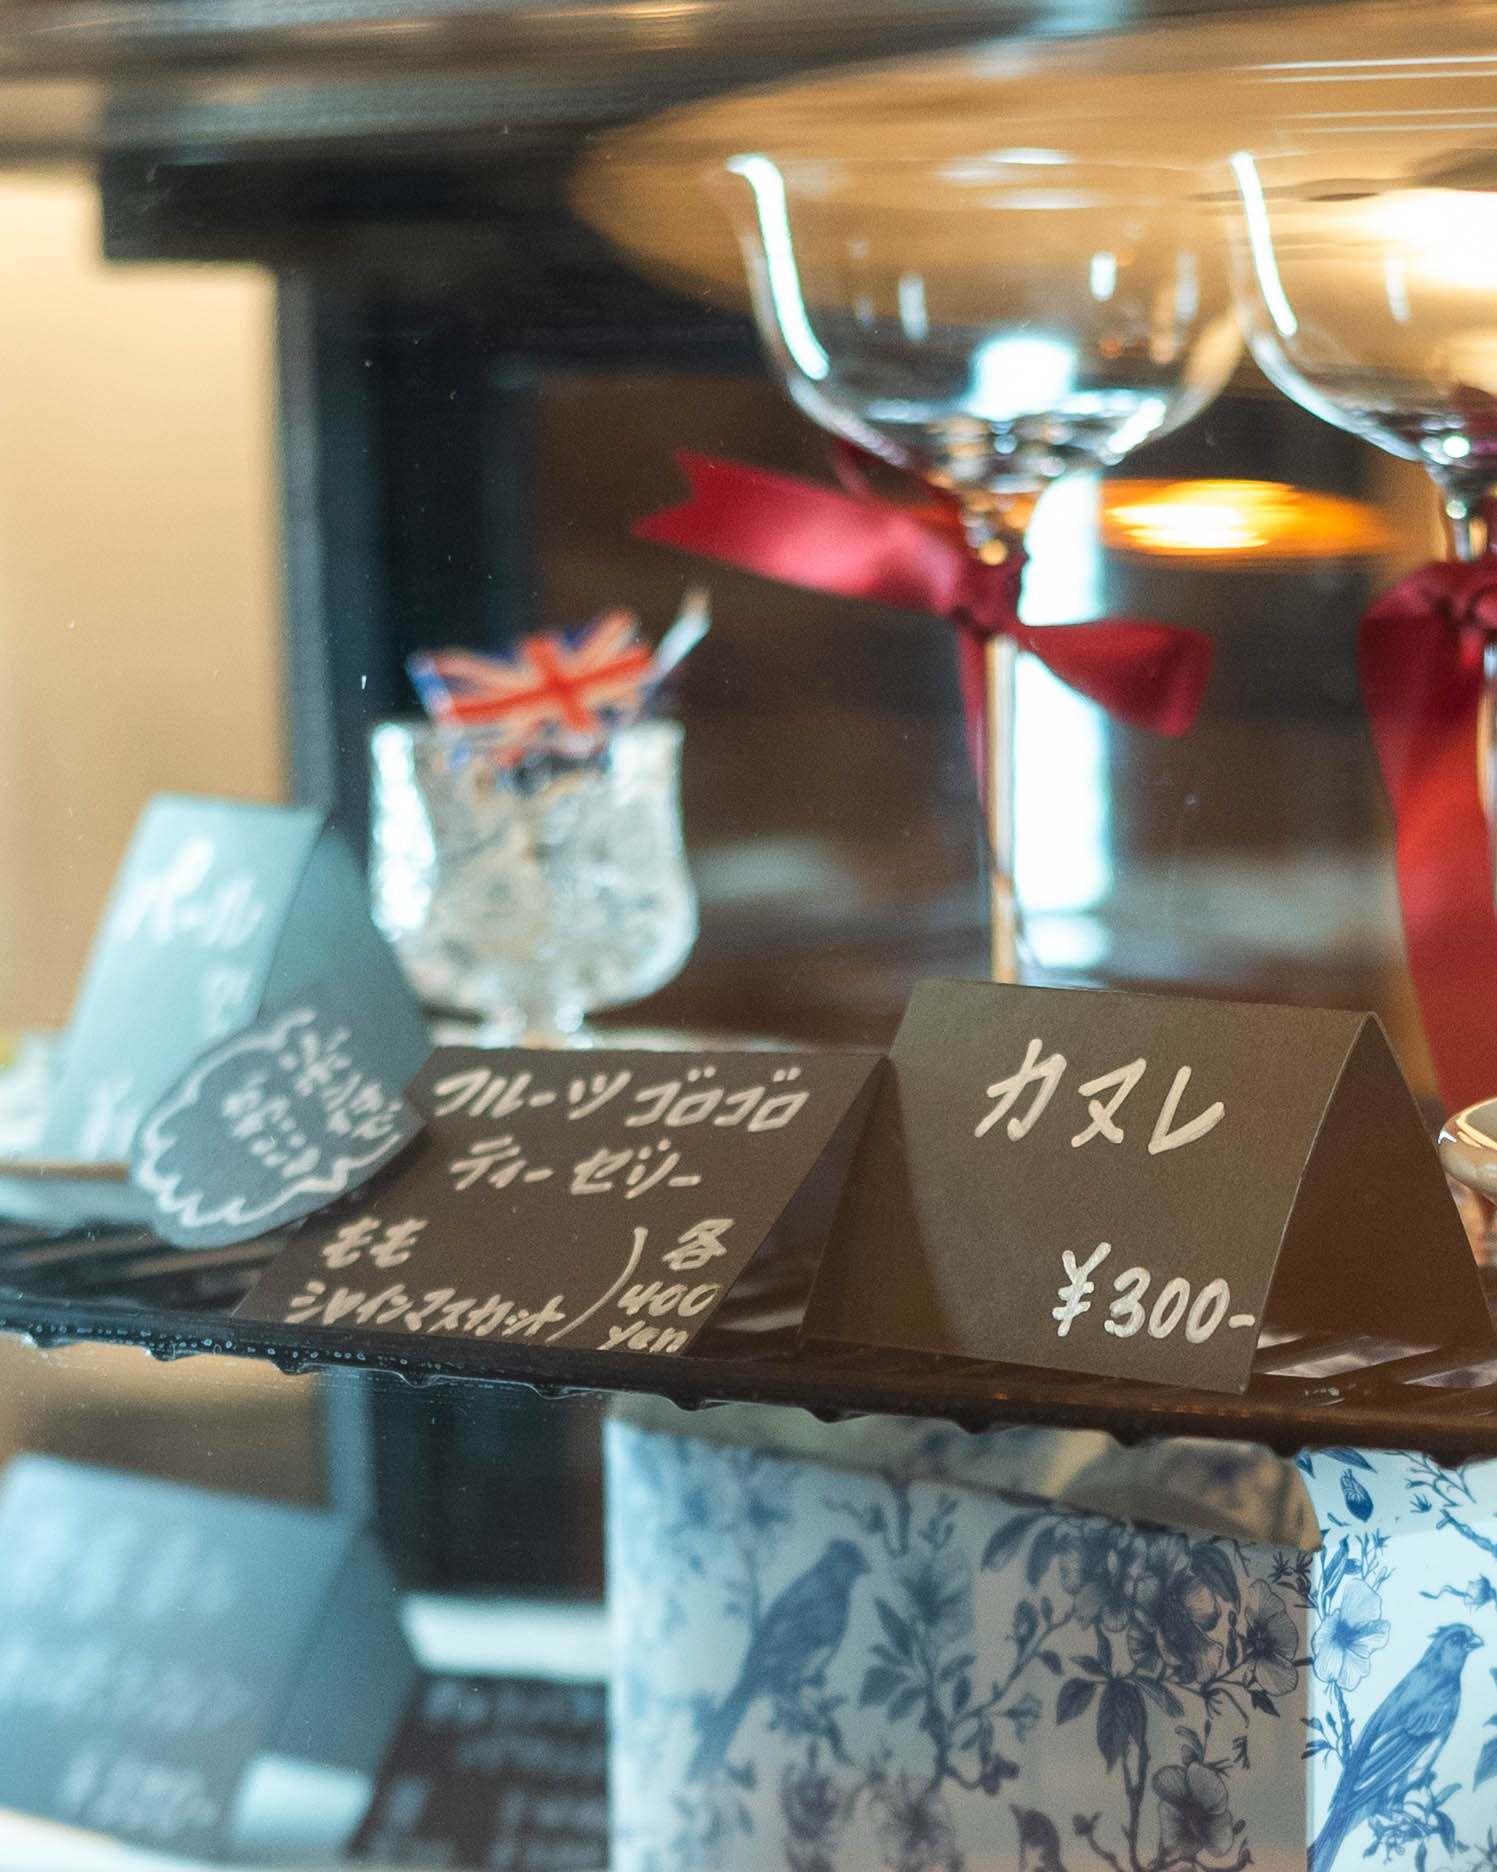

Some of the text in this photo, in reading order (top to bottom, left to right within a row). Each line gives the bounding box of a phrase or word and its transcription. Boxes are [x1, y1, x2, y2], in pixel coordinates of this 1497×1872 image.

[975, 1038, 1224, 1154] カヌレ
[323, 1218, 426, 1268] もも
[662, 1219, 733, 1270] 各
[610, 1280, 720, 1316] 400
[1052, 1242, 1255, 1343] ¥300-
